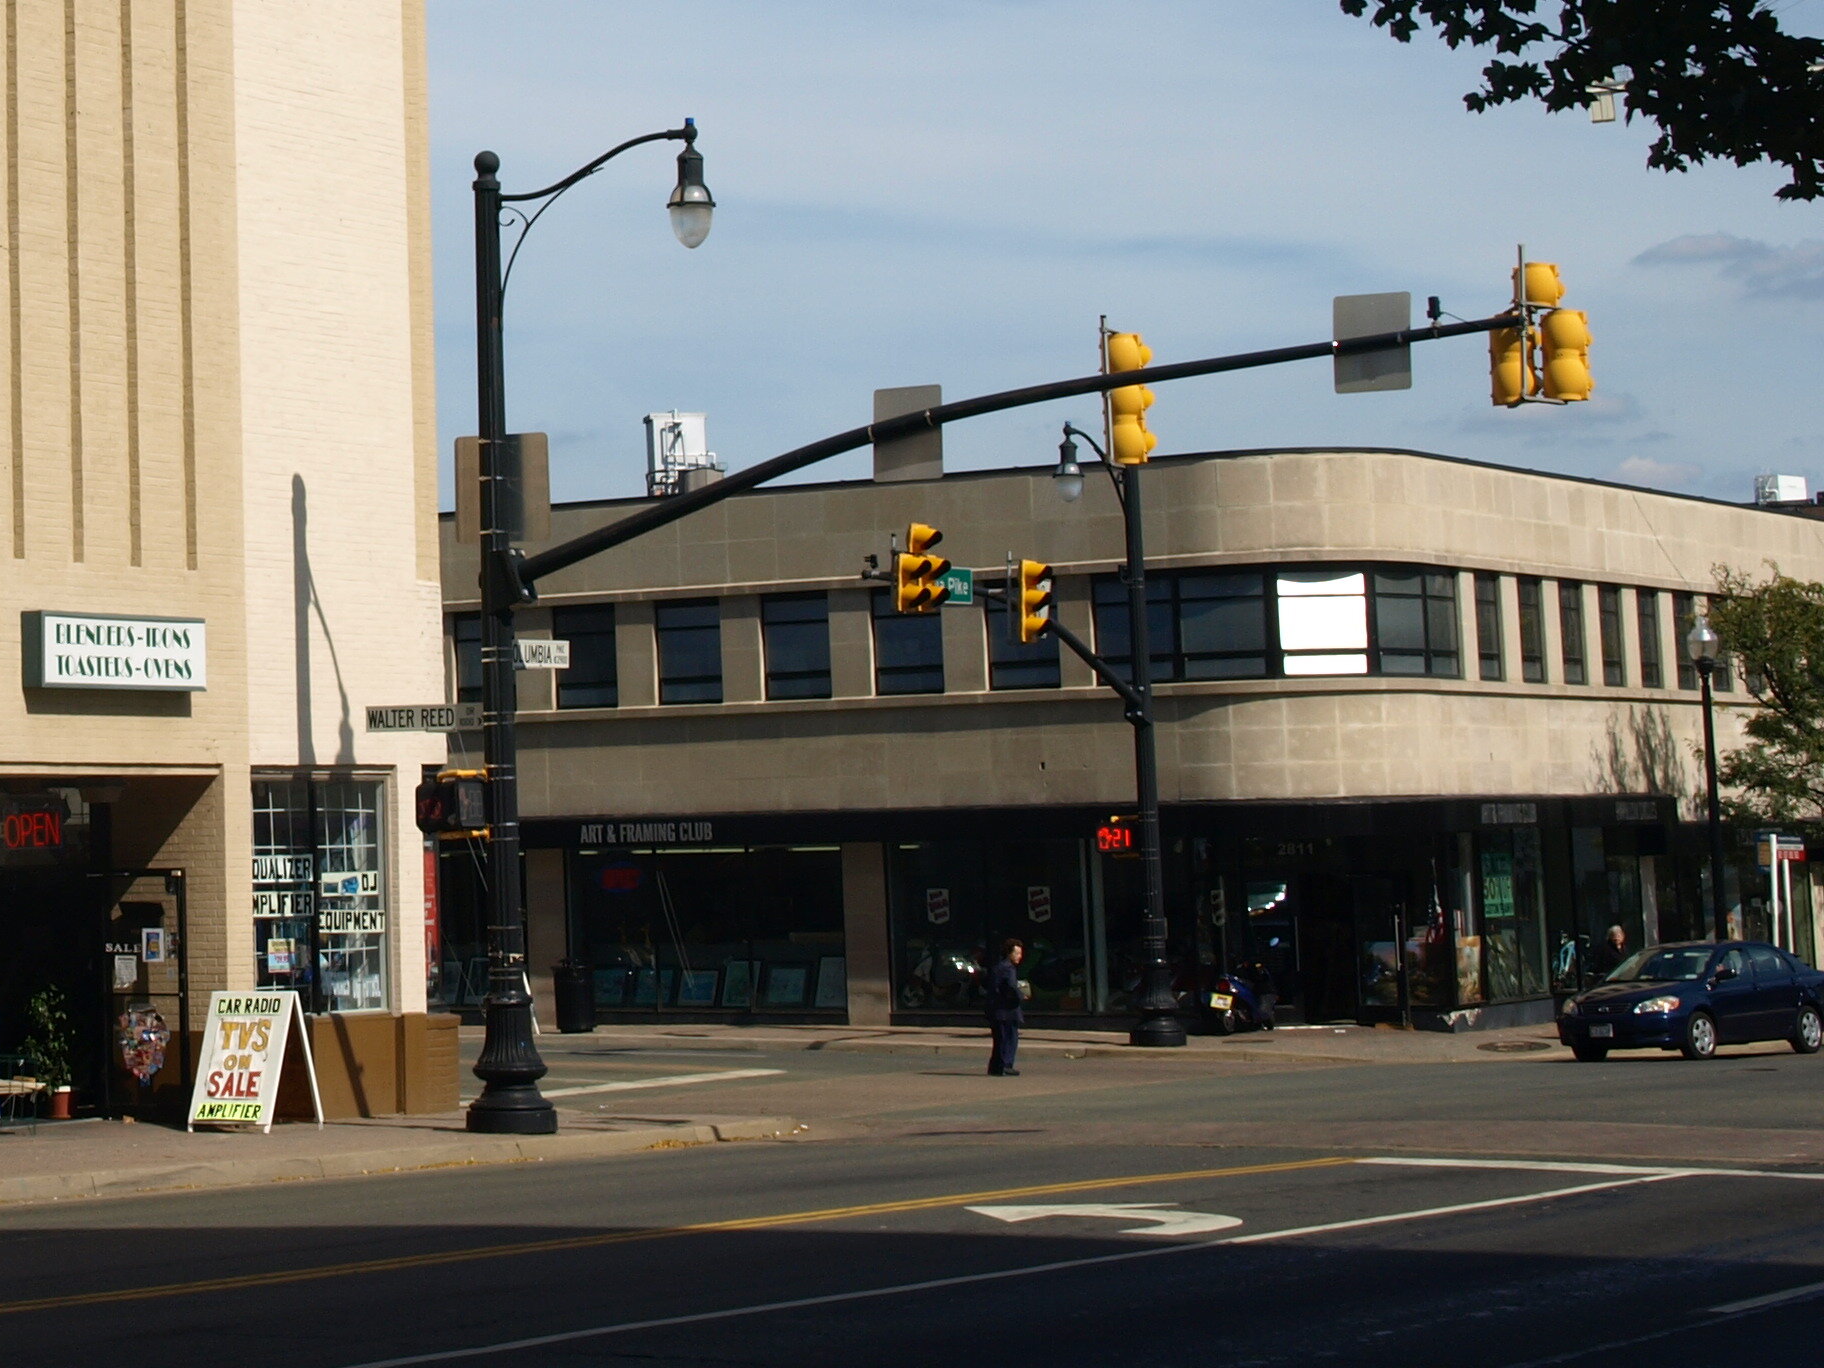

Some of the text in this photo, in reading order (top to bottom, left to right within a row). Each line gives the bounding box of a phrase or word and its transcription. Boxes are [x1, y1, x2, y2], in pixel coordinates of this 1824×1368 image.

[948, 577, 969, 595] Pike
[56, 623, 135, 648] BLENDERS
[146, 627, 192, 650] IRONS
[513, 644, 552, 664] OLUMBIA
[56, 654, 134, 678] TOASTERS
[144, 658, 193, 680] OVENS
[367, 707, 455, 730] WALTER REED
[4, 812, 61, 849] OPEN
[580, 821, 713, 843] ART & FRAMING CLUB
[252, 857, 312, 880] QUALIZER
[361, 873, 377, 891] DJ
[253, 894, 312, 915] MPLIFIER
[319, 912, 384, 931] EQUIPMENT
[105, 943, 142, 952] SALE
[218, 998, 281, 1014] CAR RADIO
[224, 1054, 253, 1071] ON
[207, 1070, 261, 1098] SALE
[197, 1104, 262, 1119] AMPLIFIER
